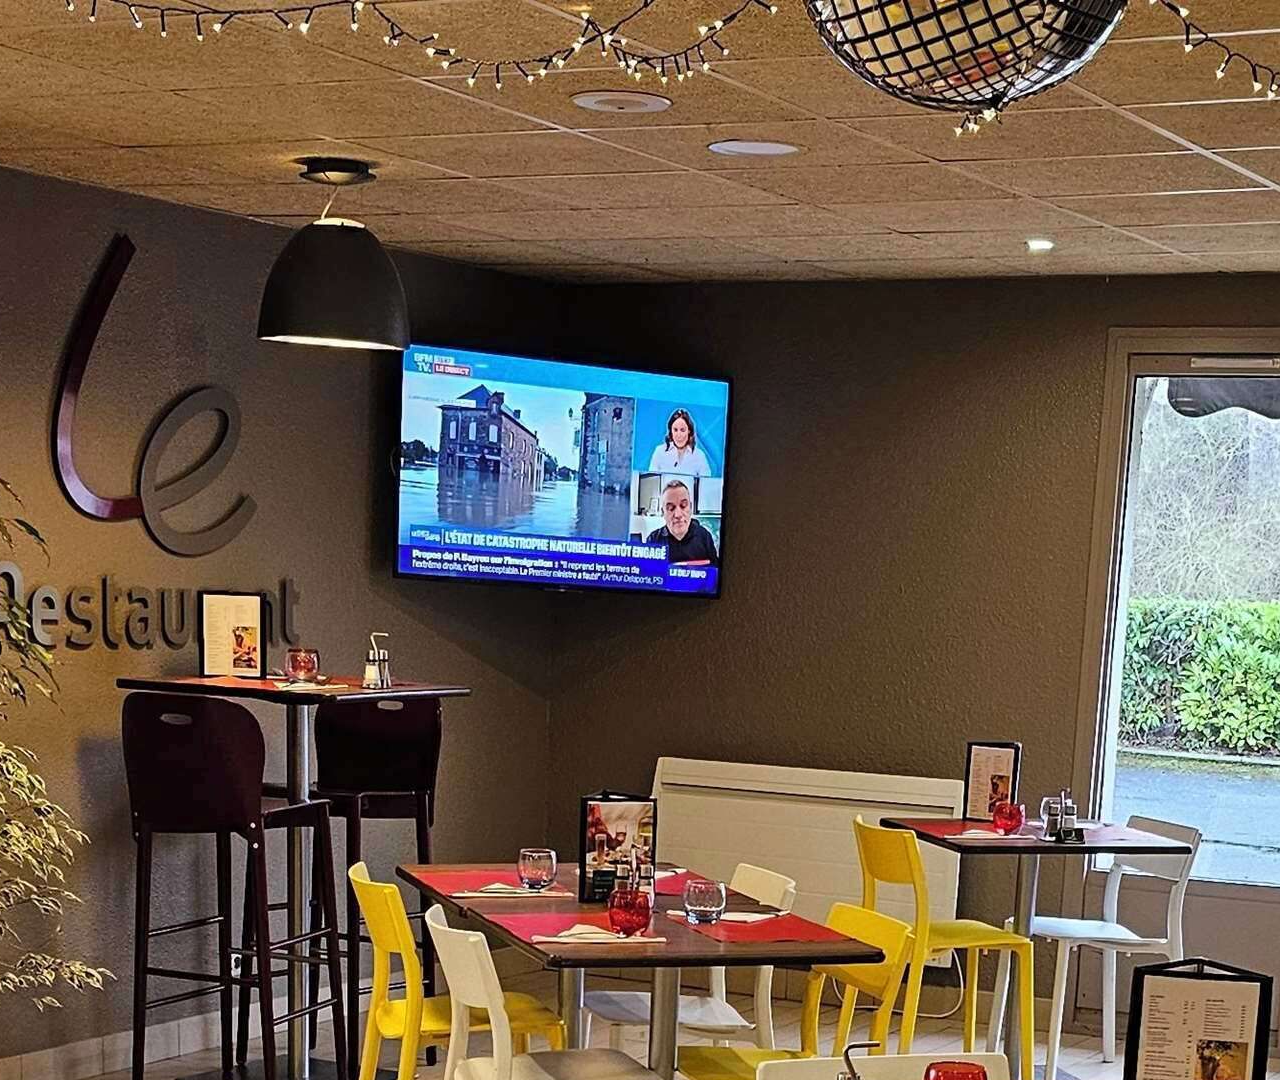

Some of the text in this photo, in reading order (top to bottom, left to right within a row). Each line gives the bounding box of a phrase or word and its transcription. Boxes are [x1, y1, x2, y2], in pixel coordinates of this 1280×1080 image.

[51, 233, 259, 557] Le
[445, 530, 473, 545] L'ÉTAT
[473, 532, 485, 546] DE
[485, 533, 548, 551] CATASTROPHE
[550, 539, 597, 554] NATURELLE
[597, 544, 633, 557] BIENTÔT
[633, 545, 666, 560] ENGAGÉ
[412, 549, 441, 561] Propos
[442, 551, 453, 560] de
[568, 562, 594, 572] reprend
[596, 563, 606, 572] les
[607, 564, 630, 574] termes
[631, 566, 640, 574] de
[463, 562, 478, 573] c'est
[520, 567, 528, 576] Le
[529, 568, 552, 579] Premier
[553, 570, 577, 579] ministre
